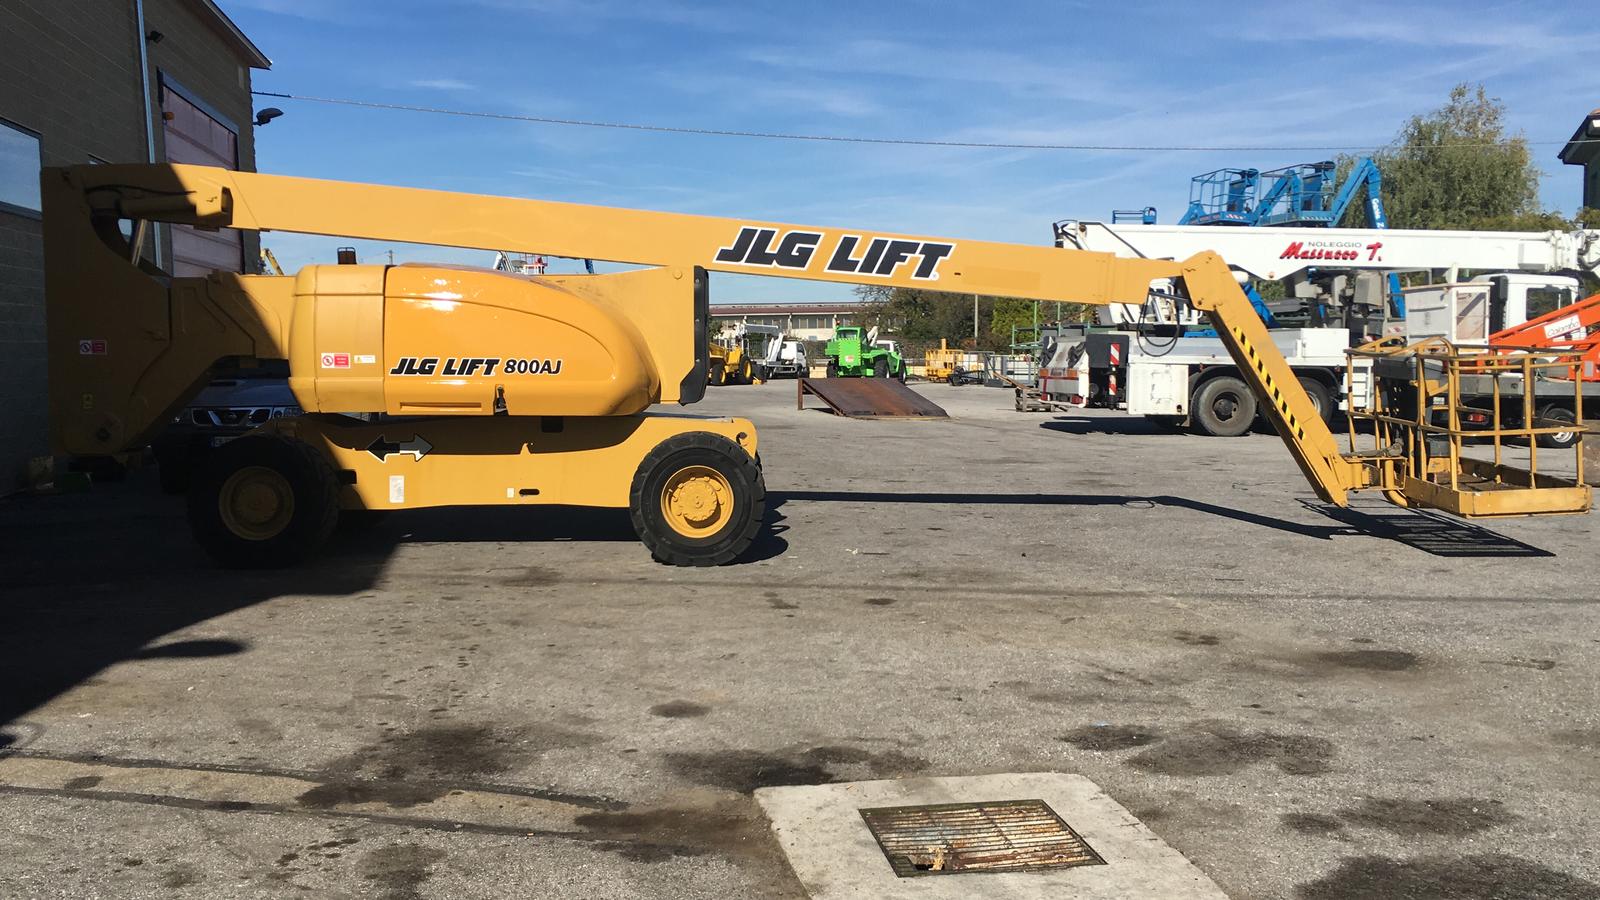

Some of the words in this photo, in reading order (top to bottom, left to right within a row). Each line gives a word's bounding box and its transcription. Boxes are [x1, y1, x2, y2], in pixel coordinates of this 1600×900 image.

[714, 226, 823, 270] JLG
[825, 235, 955, 280] LIFT
[1366, 242, 1383, 261] T.
[390, 357, 440, 376] JLG
[442, 358, 500, 376] LIFT
[503, 359, 562, 375] 800AJ
